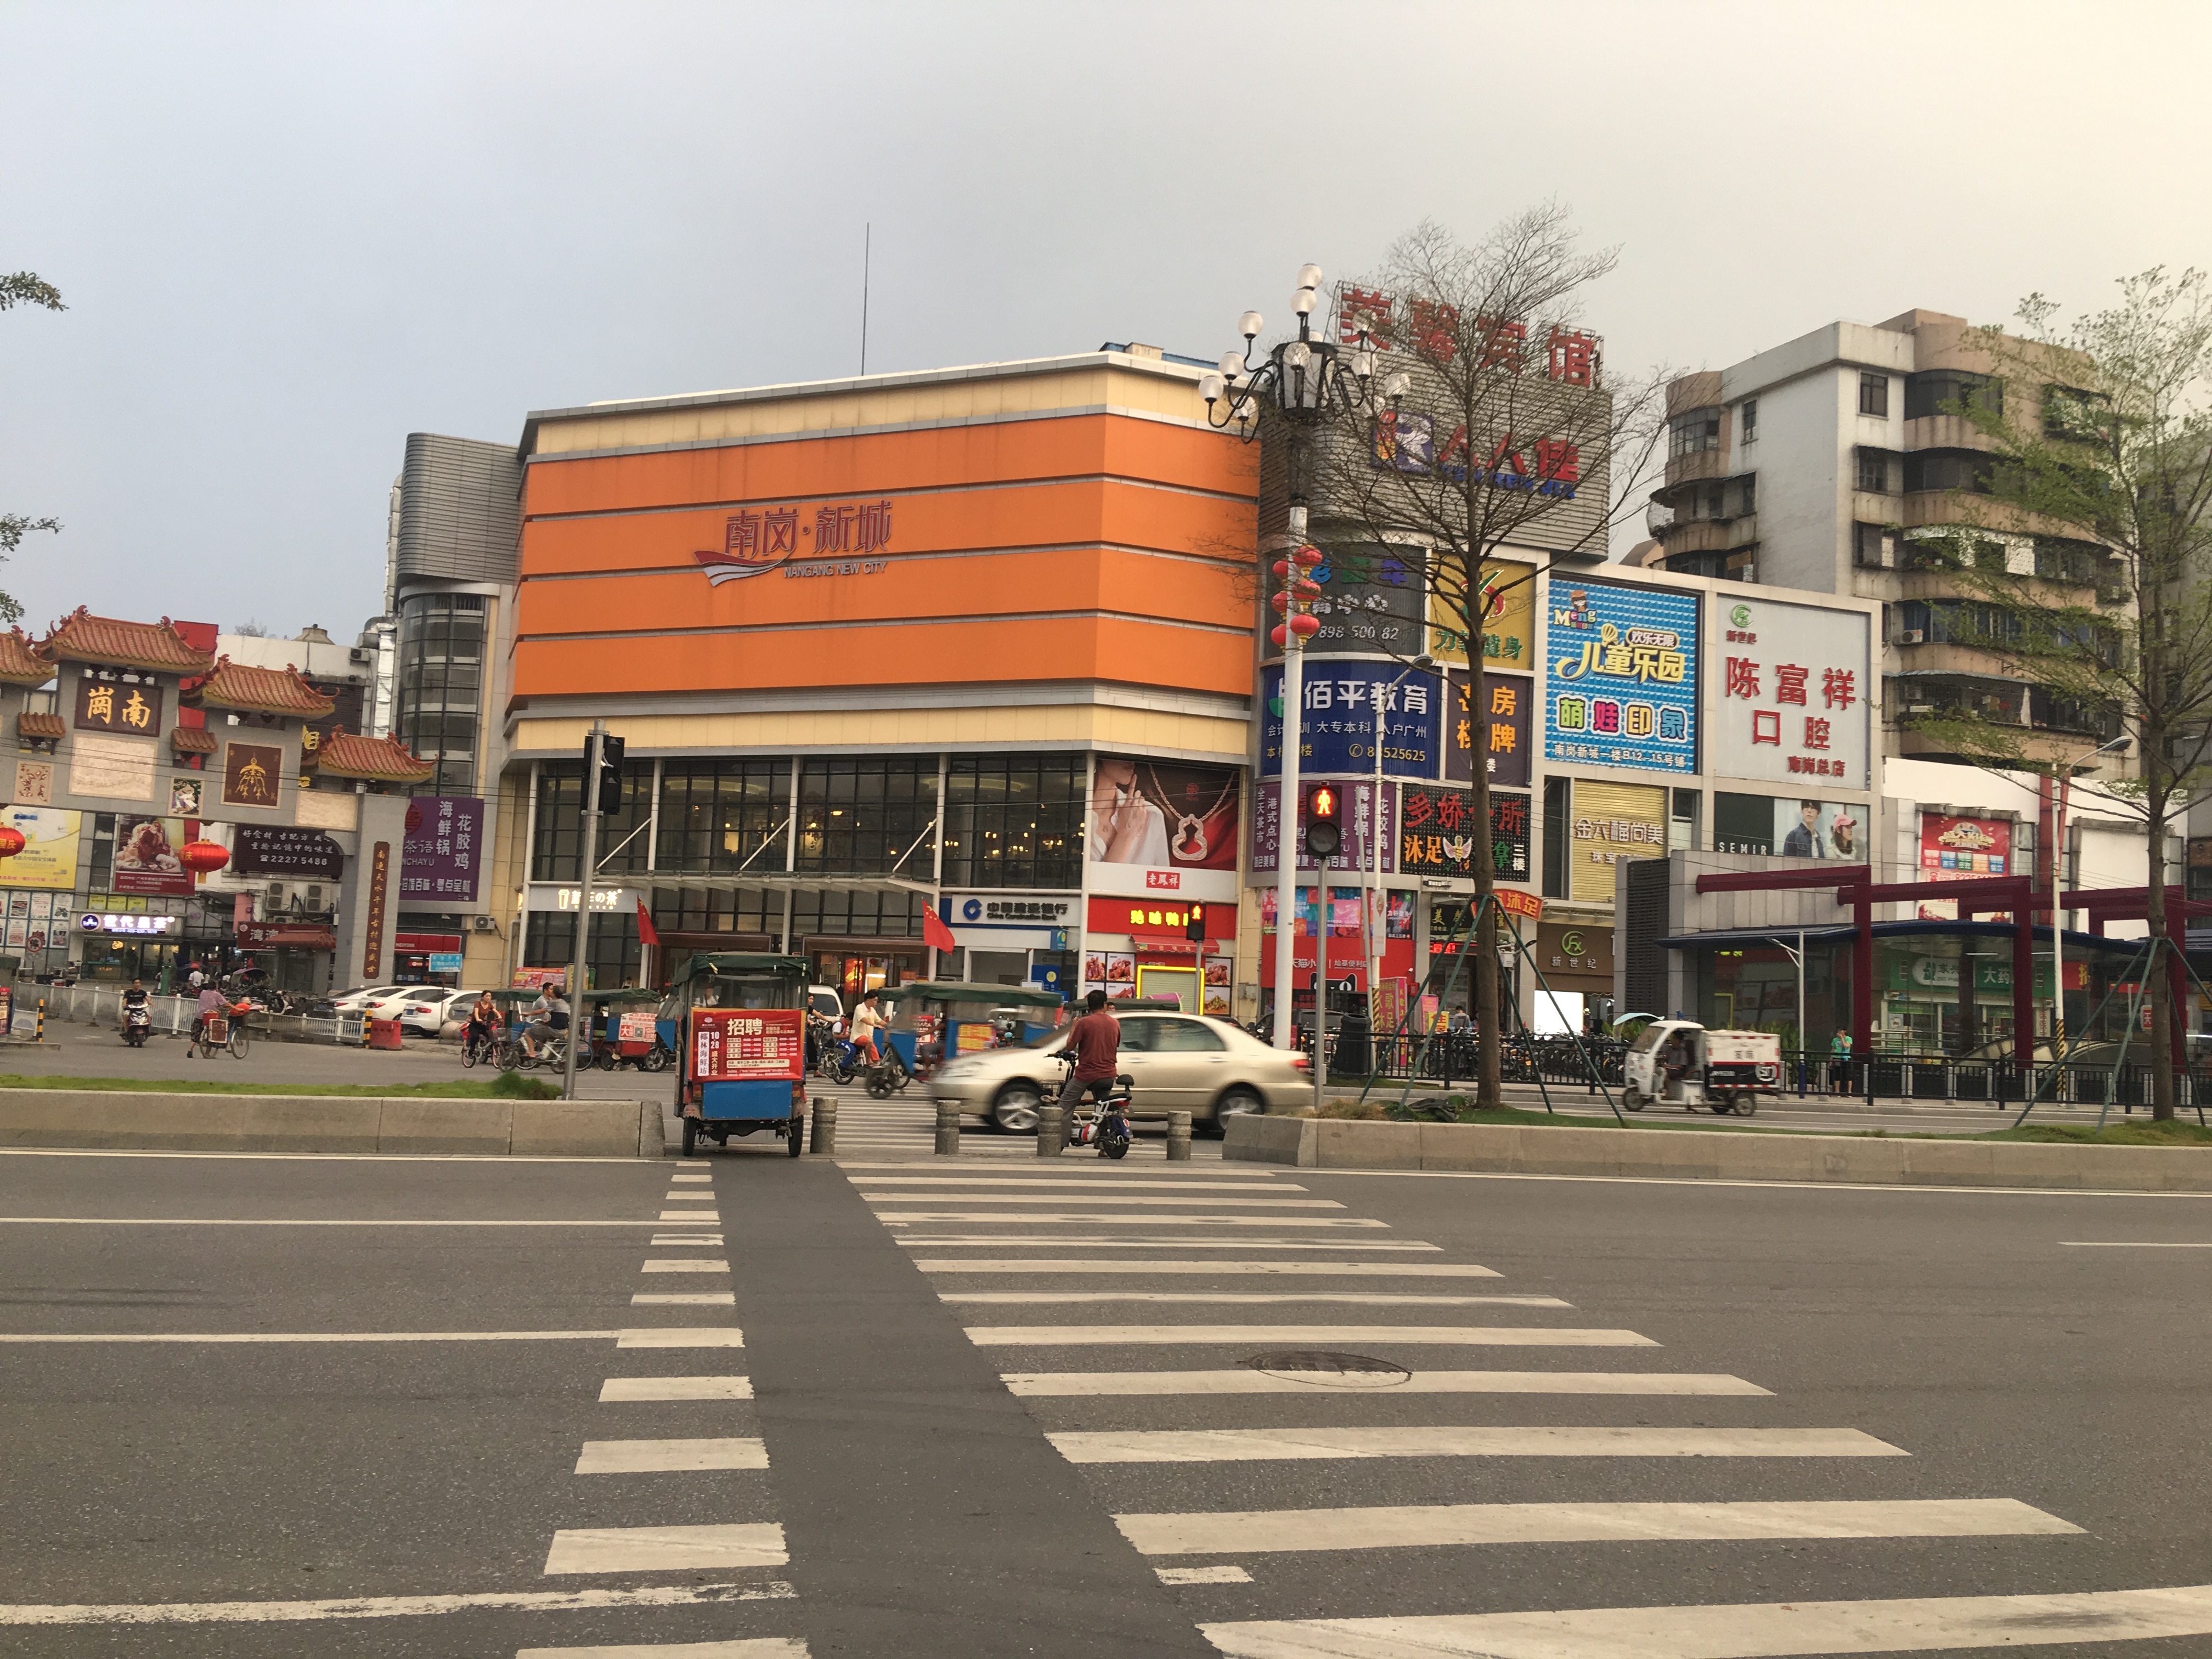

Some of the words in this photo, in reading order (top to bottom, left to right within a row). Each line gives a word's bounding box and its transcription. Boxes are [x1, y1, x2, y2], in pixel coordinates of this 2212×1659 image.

[784, 566, 833, 578] NANGANG
[837, 563, 860, 575] NEW
[864, 562, 887, 574] CITY
[1554, 609, 1596, 626] Meng
[1381, 627, 1399, 640] 82
[1632, 630, 1674, 647] 欢乐无限
[1556, 641, 1685, 683] 儿童乐园
[1726, 657, 1856, 710] 陈富祥
[1305, 680, 1427, 714] 佰平教育
[1317, 720, 1371, 734] 大专本科
[1559, 699, 1686, 740] 萌娃印象
[1753, 710, 1830, 749] 口腔
[1367, 747, 1425, 761] 8525625
[436, 800, 453, 856] 海鲜锅
[1266, 797, 1278, 850] 港式点心
[1575, 817, 1664, 844] 金六福尚美
[454, 814, 472, 870] 花胶鸡
[1404, 834, 1443, 864] 沐足
[1719, 842, 1767, 855] SEMIR
[270, 855, 298, 864] 2227
[1513, 844, 1526, 871] 三楼
[987, 902, 1068, 915] 中国建设银行
[1551, 956, 1596, 969] 新世纪
[727, 1018, 763, 1036] 招聘
